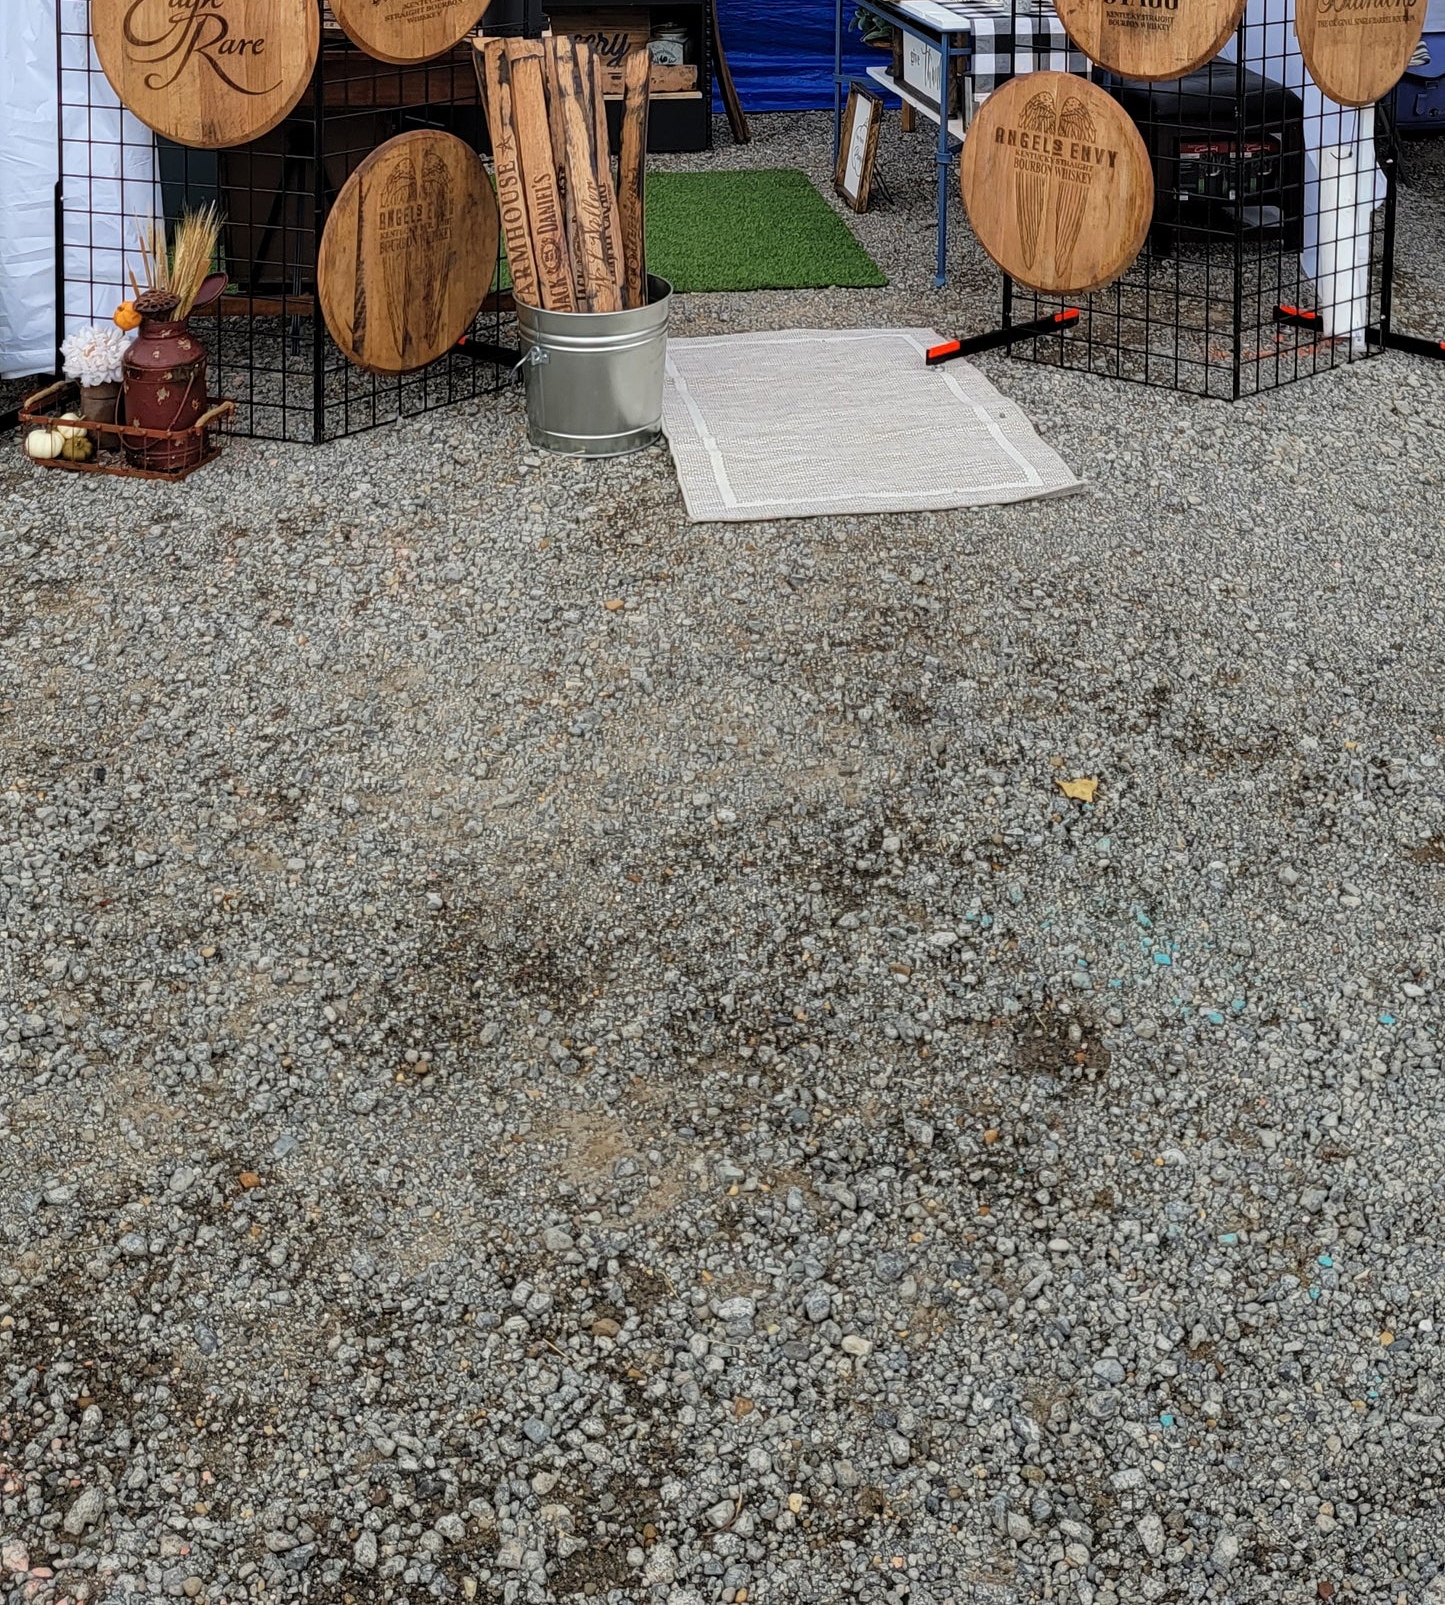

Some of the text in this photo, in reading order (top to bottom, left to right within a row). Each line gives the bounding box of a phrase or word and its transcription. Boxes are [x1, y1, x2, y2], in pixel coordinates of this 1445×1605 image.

[384, 6, 425, 22] STRAIGHT
[1106, 10, 1174, 24] KENTUCKY STRAIGHT
[1108, 18, 1170, 31] BOURBON WHISKEY
[144, 13, 283, 95] Rare
[995, 126, 1118, 168] ANGELS ENVY
[1014, 157, 1092, 185] BOURBON WHISKEY
[1015, 149, 1094, 173] KENTUCKY STRAIGHT
[531, 172, 572, 312] JACK DANIEL'S
